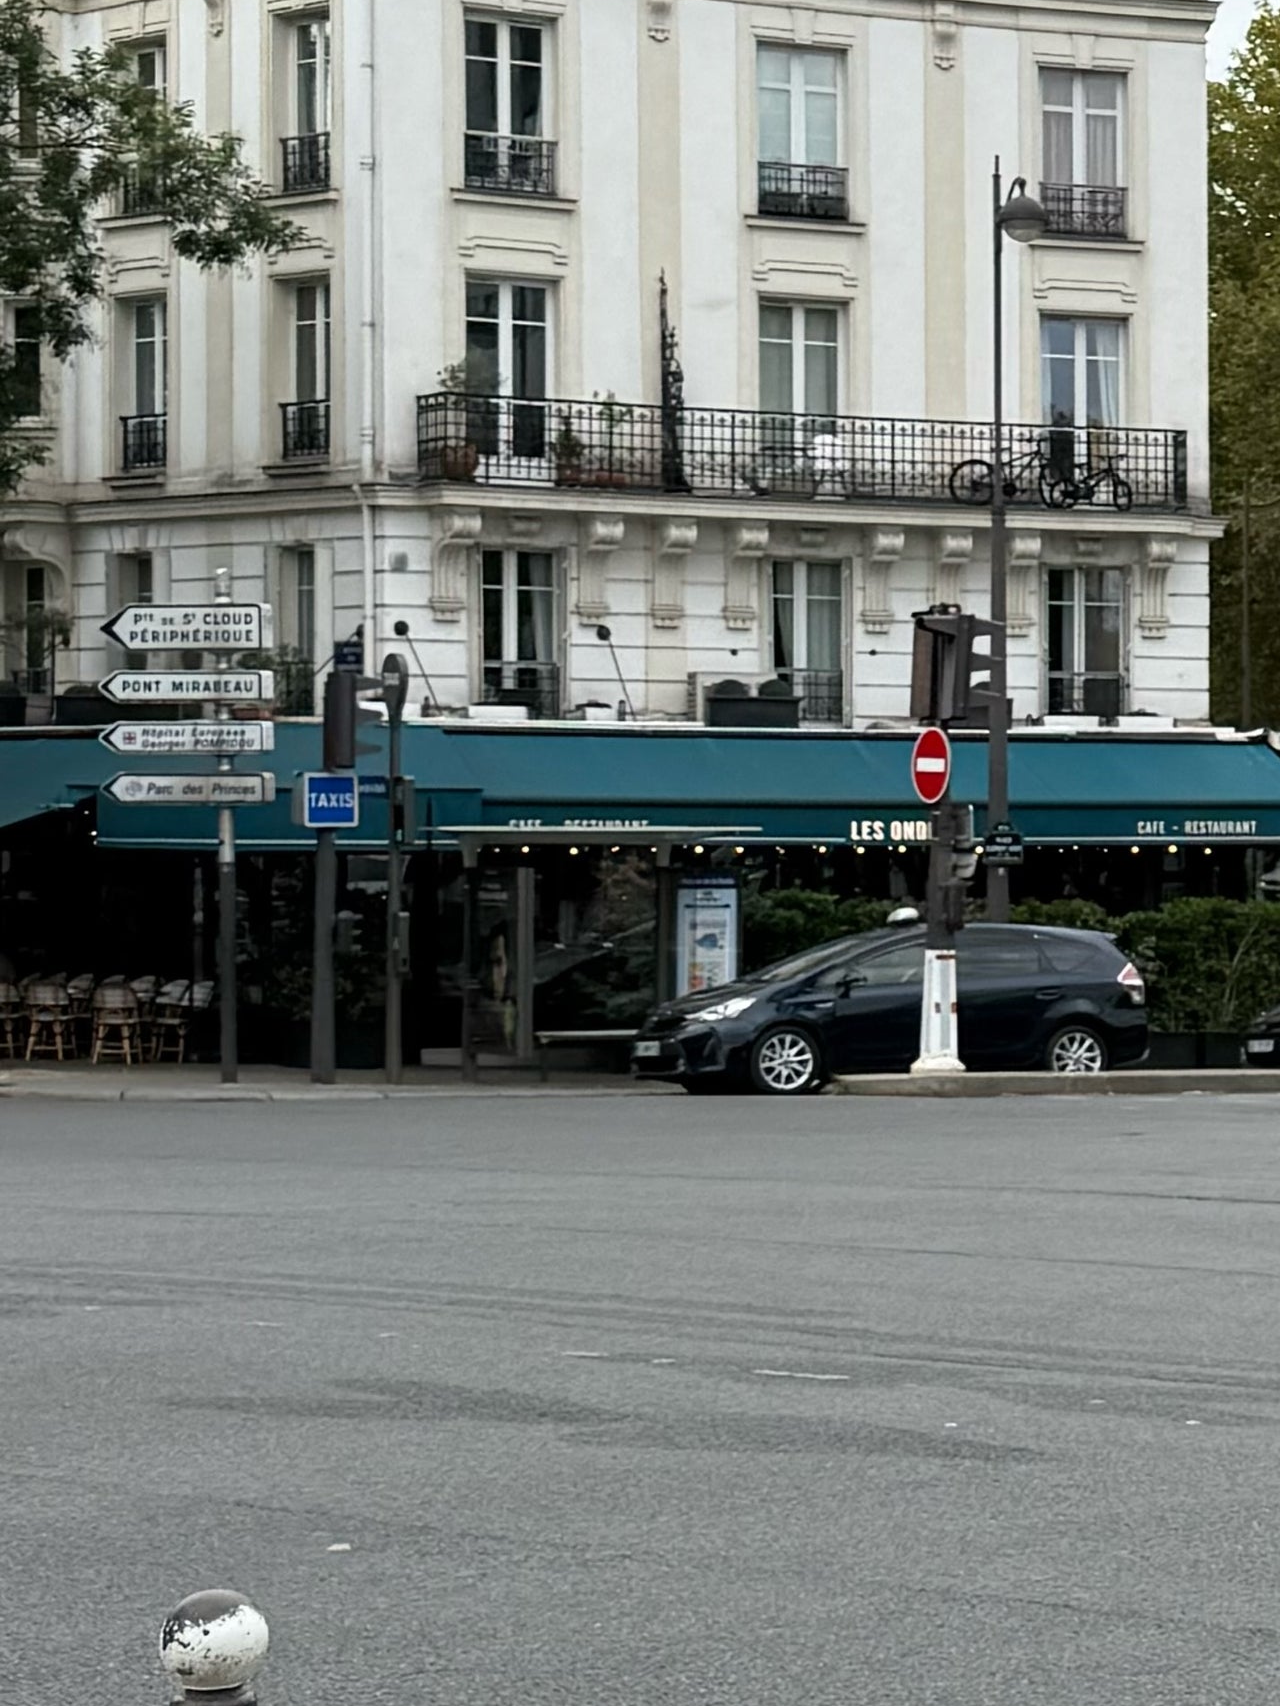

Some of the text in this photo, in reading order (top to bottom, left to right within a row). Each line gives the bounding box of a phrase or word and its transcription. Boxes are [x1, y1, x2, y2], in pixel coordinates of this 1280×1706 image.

[203, 613, 253, 625] CLOUD
[130, 628, 253, 643] PÉRIPHÉRIQUE
[122, 680, 254, 693] PONT MIRABEAU
[147, 782, 256, 795] Parc des Princes
[310, 793, 354, 808] TAXIS
[851, 820, 885, 841] LES
[1137, 820, 1165, 834] CAFE
[1184, 820, 1256, 834] RESTAURANT
